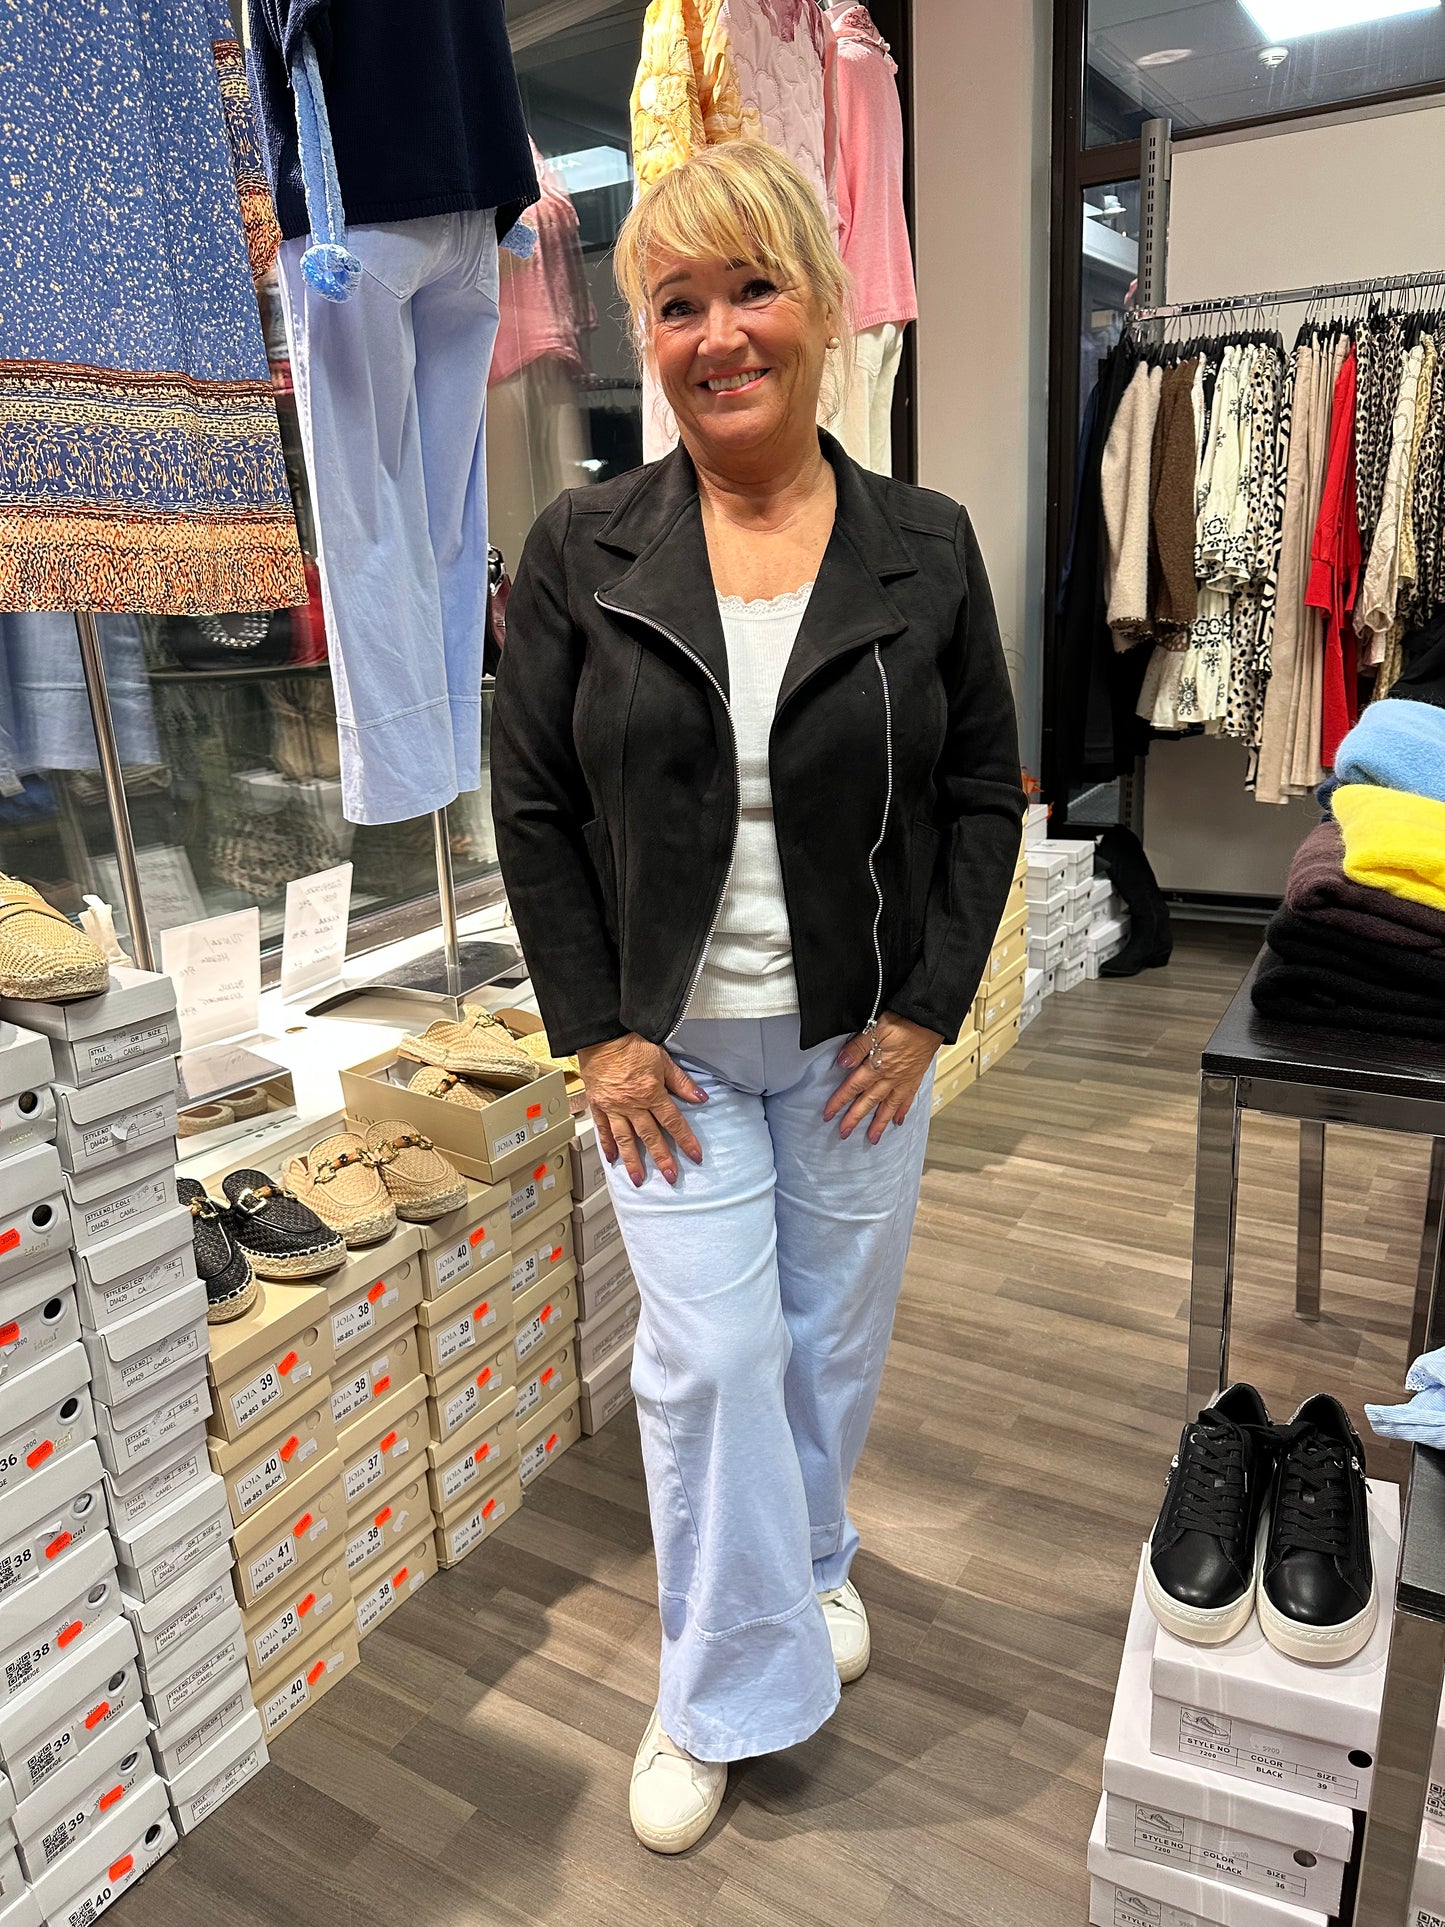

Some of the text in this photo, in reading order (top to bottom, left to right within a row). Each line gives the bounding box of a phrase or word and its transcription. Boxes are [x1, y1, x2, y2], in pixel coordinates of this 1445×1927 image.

[90, 1029, 160, 1056] STYLE SIZE
[85, 1130, 101, 1140] STYLE
[515, 1130, 525, 1144] 39
[526, 1185, 534, 1199] 36
[87, 1210, 100, 1221] STYLE
[91, 1219, 109, 1232] DM429
[457, 1244, 467, 1258] 40
[526, 1258, 534, 1271] 38
[106, 1288, 120, 1299] STYLE
[336, 1302, 369, 1328] JOIA 38
[459, 1321, 469, 1335] 39
[533, 1318, 540, 1332] 37
[124, 1364, 137, 1376] STYLE
[178, 1335, 190, 1345] SIZE
[236, 1373, 273, 1408] JOIA 39
[333, 1391, 351, 1407] JOIA
[355, 1378, 366, 1393] 38
[465, 1387, 475, 1401] 39
[529, 1382, 537, 1396] 37
[179, 1400, 192, 1409] SIZE
[262, 1390, 279, 1406] BLACK
[354, 1393, 368, 1407] BLACK
[160, 1422, 176, 1435] CAMEL
[0, 1453, 18, 1472] 36
[178, 1462, 190, 1472] SIZE
[347, 1454, 378, 1484] JOIA 37
[464, 1456, 473, 1470] 40
[241, 1458, 277, 1494] JOIA 40
[265, 1475, 282, 1490] BLACK
[367, 1470, 381, 1484] BLACK
[156, 1485, 172, 1498] CAMEL
[472, 1515, 479, 1528] 41
[347, 1527, 378, 1556] JOIA 38
[367, 1542, 380, 1555] BLACK
[13, 1548, 32, 1568] 38
[254, 1541, 289, 1576] JOIA 41
[277, 1557, 294, 1573] BLACK
[360, 1584, 389, 1616] JOIA 38
[380, 1597, 392, 1611] BLACK
[180, 1606, 198, 1622] COLOR
[259, 1613, 293, 1649] JOIA 39
[282, 1627, 298, 1643] BLACK
[32, 1643, 50, 1662] 38
[192, 1661, 210, 1678] COLOR
[197, 1671, 213, 1685] CAMEL
[268, 1679, 302, 1715] JOIA 40
[290, 1694, 306, 1709] BLACK
[103, 1700, 124, 1722] ideal
[201, 1716, 218, 1732] COLOR
[54, 1732, 70, 1752] 39
[1187, 1737, 1337, 1782] STYLE NO COLOR SIZE
[1199, 1750, 1217, 1758] 7200
[1256, 1766, 1283, 1779] BLACK
[222, 1777, 237, 1792] CAMEL
[68, 1812, 84, 1832] 39
[1142, 1833, 1286, 1880] STYLE NO COLOR SIZE
[1154, 1846, 1285, 1890] 7200 BLACK 36
[96, 1888, 111, 1907] 40
